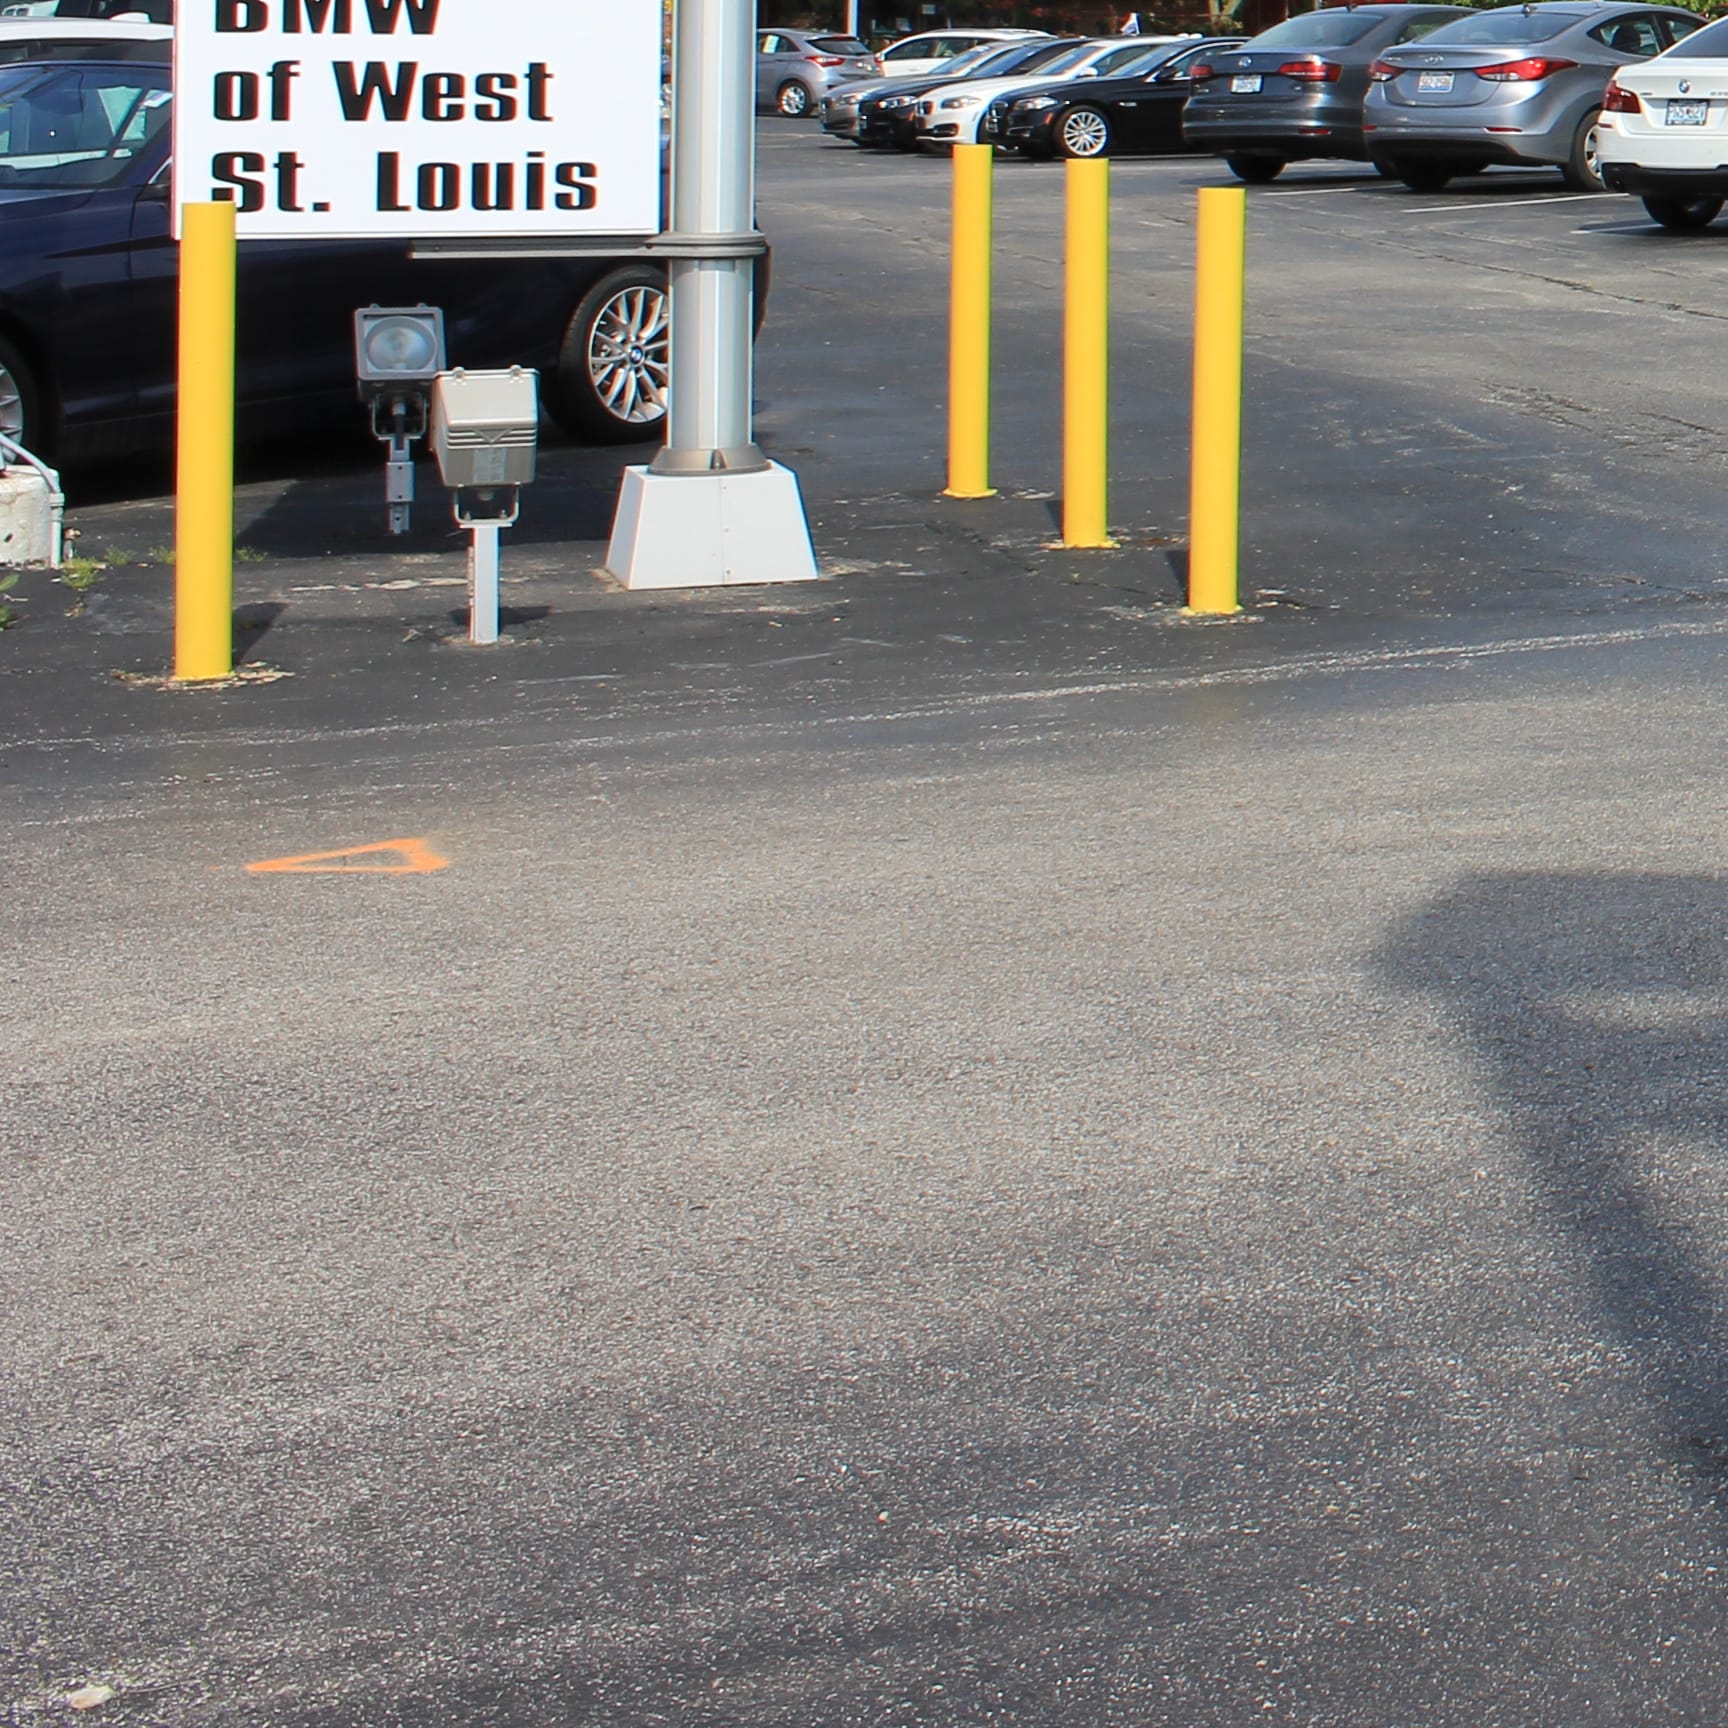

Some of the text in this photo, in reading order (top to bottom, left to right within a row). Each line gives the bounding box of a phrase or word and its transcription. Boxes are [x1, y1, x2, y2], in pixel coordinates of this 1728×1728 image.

[212, 61, 556, 122] of West
[211, 151, 598, 212] St. Louis
